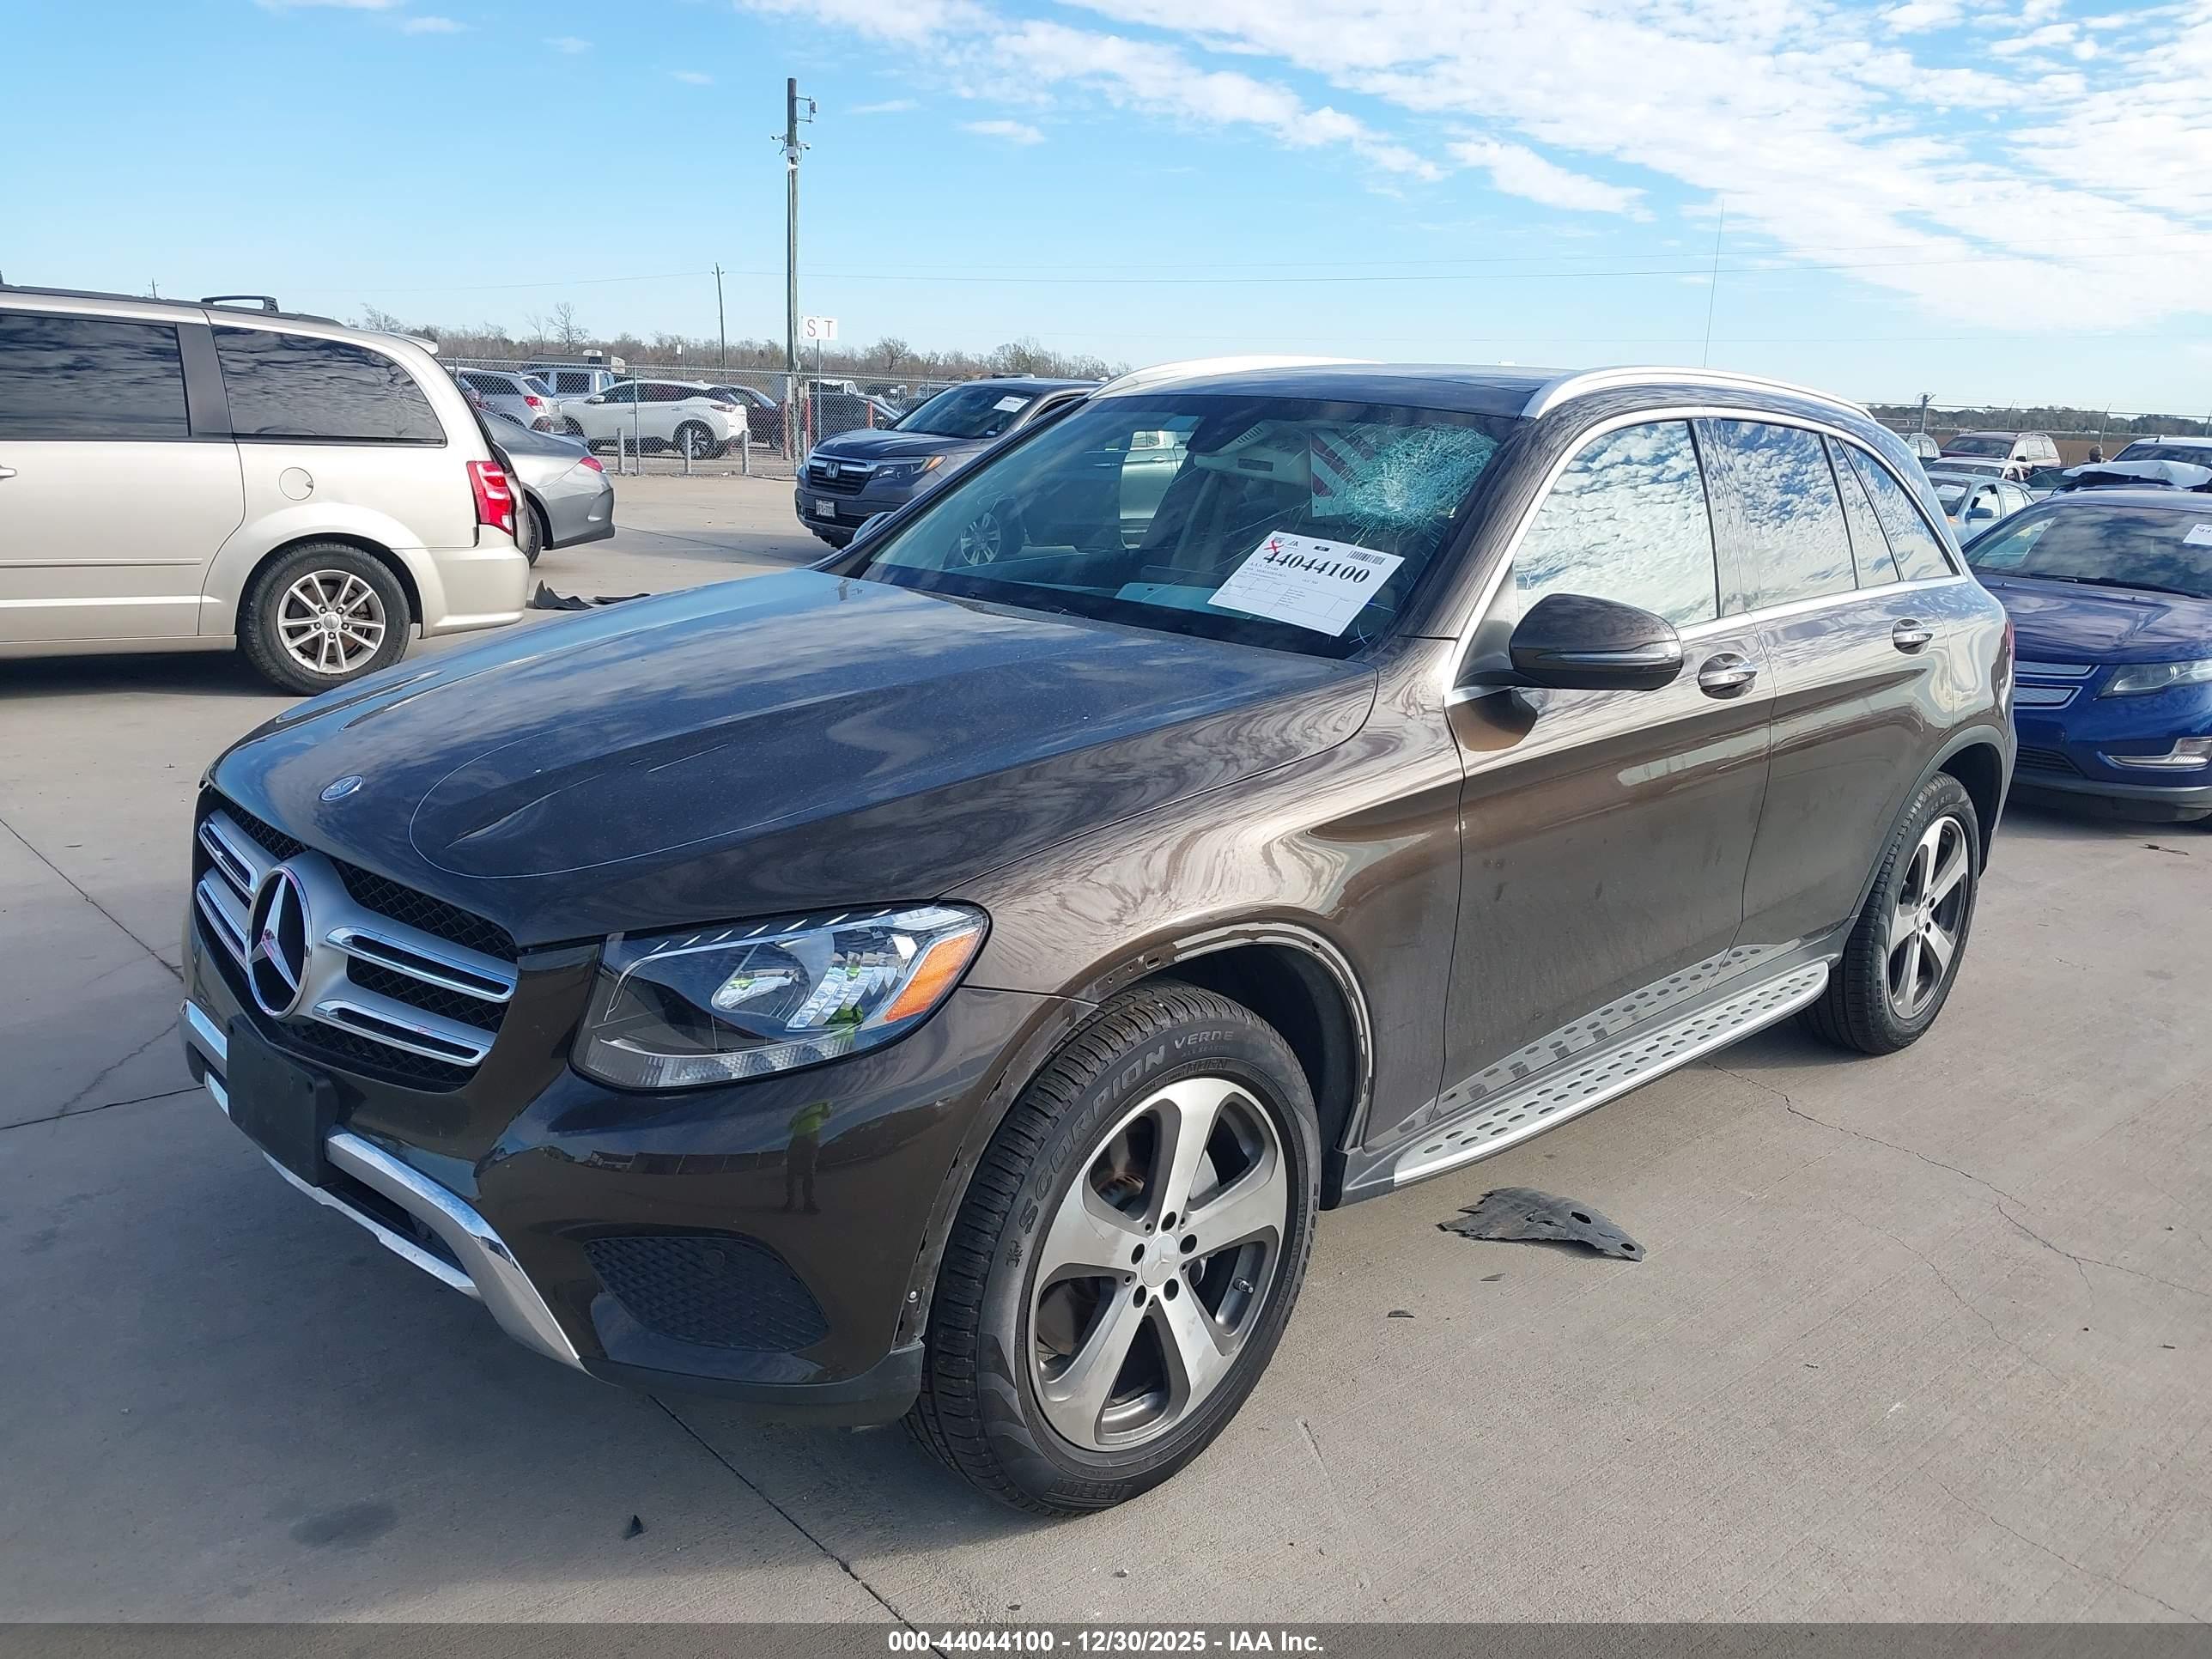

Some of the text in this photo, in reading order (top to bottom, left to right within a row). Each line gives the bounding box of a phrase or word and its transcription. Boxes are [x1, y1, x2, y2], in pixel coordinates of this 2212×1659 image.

[1263, 550, 1370, 584] 44044100
[1018, 1030, 1235, 1234] SCORPION VERDE
